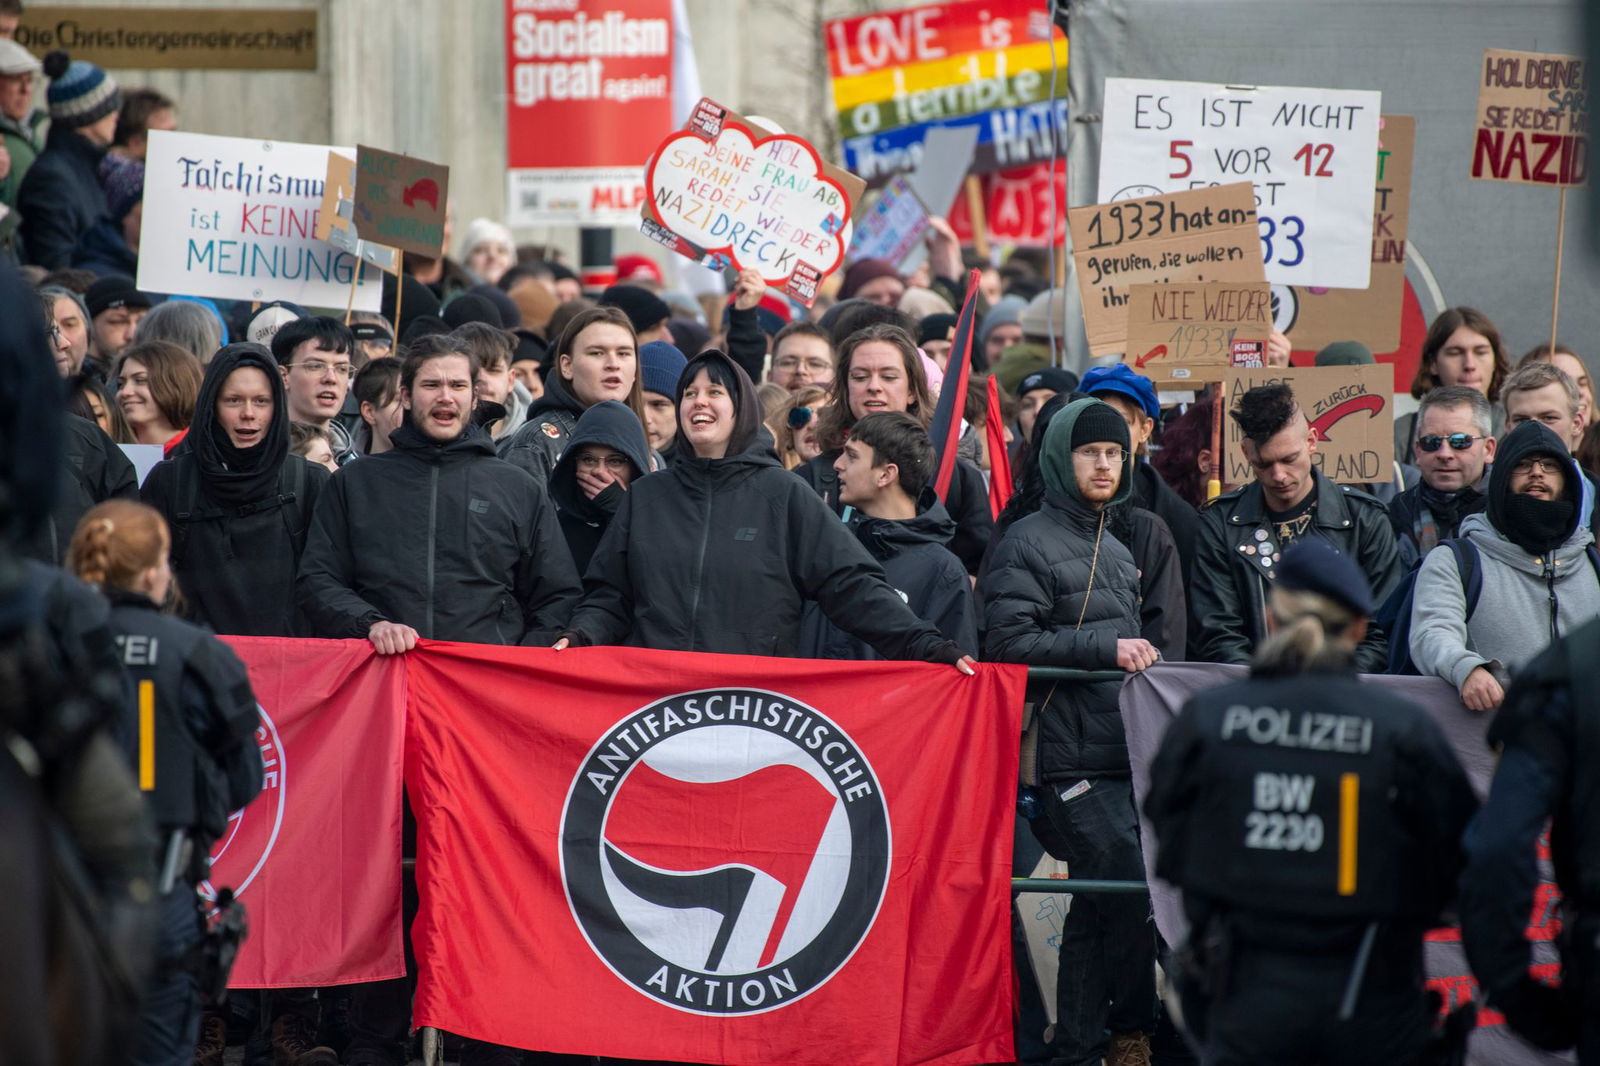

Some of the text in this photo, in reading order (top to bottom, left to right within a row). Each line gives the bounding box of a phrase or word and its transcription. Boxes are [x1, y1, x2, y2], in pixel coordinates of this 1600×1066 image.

[13, 20, 315, 53] Die Christengemeinschaft
[513, 11, 669, 59] Socialism
[831, 8, 947, 75] LOVE
[979, 11, 1013, 48] is
[513, 57, 667, 107] great again!
[852, 51, 1042, 134] a terrible
[1485, 56, 1523, 88] HOL
[1525, 58, 1582, 90] DEINE
[1134, 95, 1364, 130] ES IST NICHT
[768, 140, 801, 169] HOL
[1169, 140, 1335, 179] 5 VOR 12
[1471, 127, 1589, 185] NAZID
[687, 177, 748, 212] REDET
[761, 162, 811, 193] FRAU
[190, 207, 222, 231] ist
[1088, 200, 1256, 250] 1933 hat an-
[187, 238, 367, 286] MEINUNG!
[1088, 253, 1157, 285] gerufen,
[1159, 252, 1182, 268] die
[1186, 245, 1244, 263] wollen
[1152, 288, 1270, 322] NIE WIEDER
[1169, 325, 1238, 359] 1933!
[1234, 342, 1256, 351] KEIN
[1235, 352, 1261, 361] BOCK
[1313, 383, 1367, 415] ZURÜCK
[586, 694, 873, 803] ANTIFASCHISTISCHE
[1220, 704, 1373, 754] POLIZEI
[1253, 771, 1315, 813] BW
[1245, 811, 1325, 852] 2230
[645, 965, 799, 1008] AKTION
